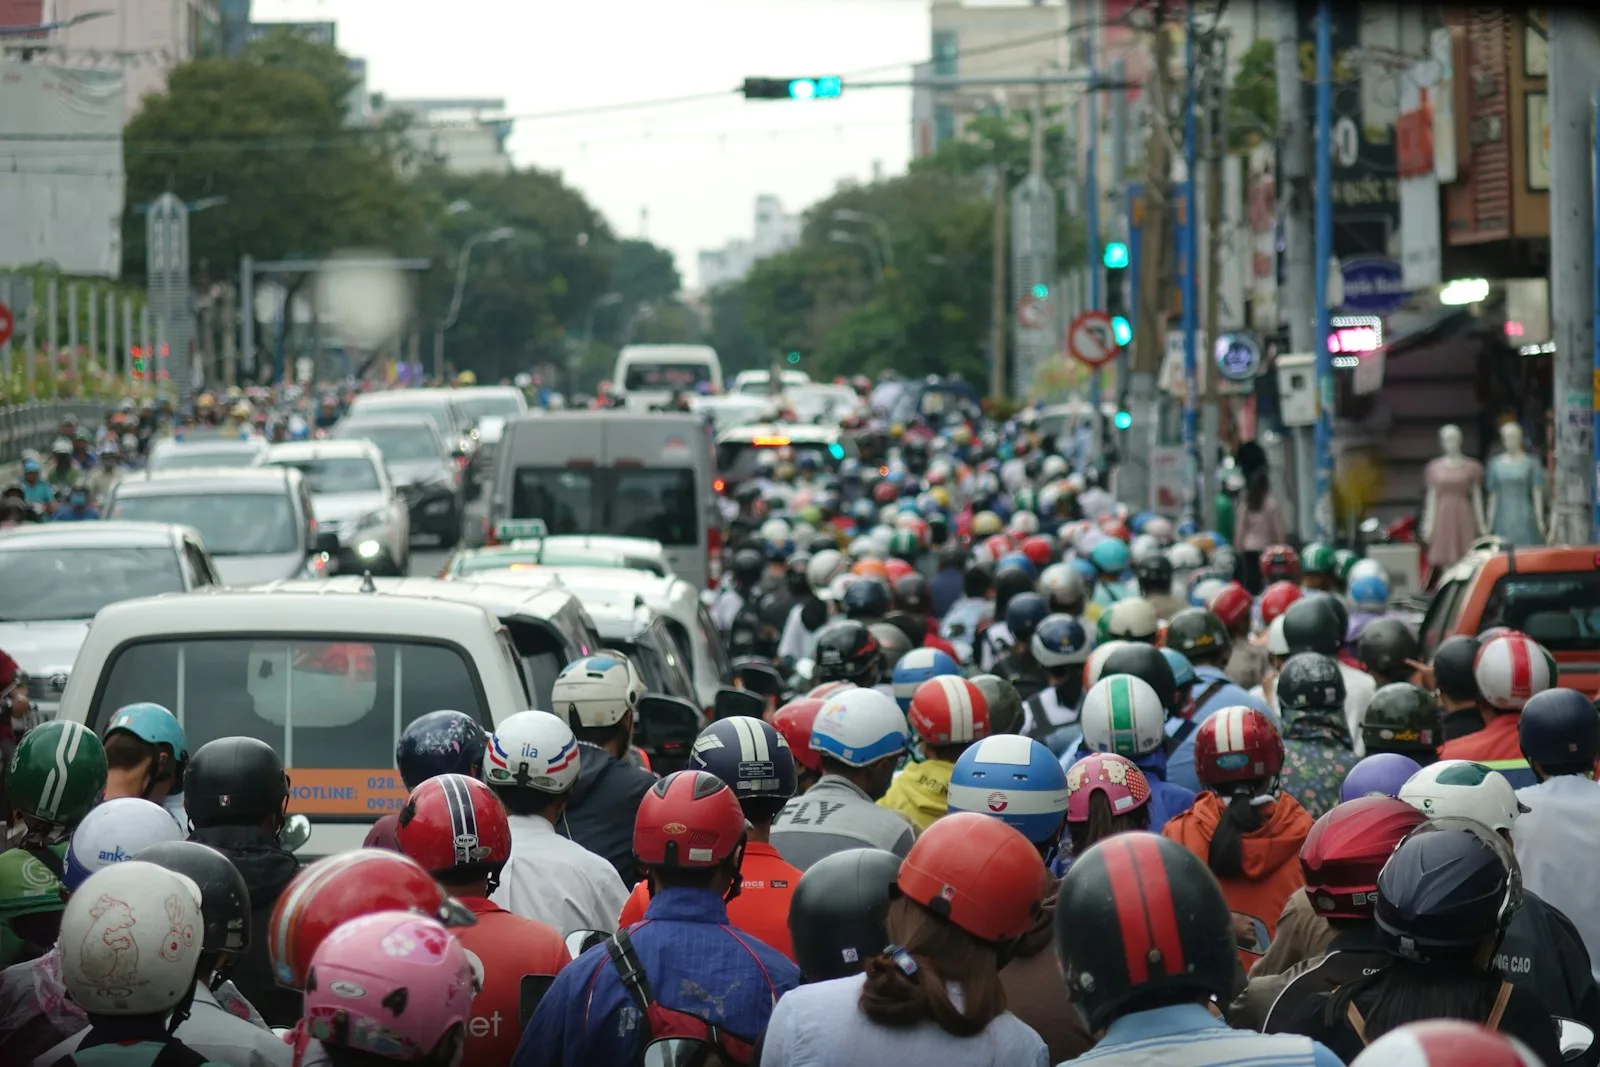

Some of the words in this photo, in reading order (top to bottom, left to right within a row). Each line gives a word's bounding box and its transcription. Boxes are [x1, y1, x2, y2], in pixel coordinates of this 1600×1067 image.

[521, 742, 538, 758] ila
[290, 786, 358, 800] HOTLINE:
[772, 801, 846, 825] FLY
[469, 1010, 503, 1037] et
